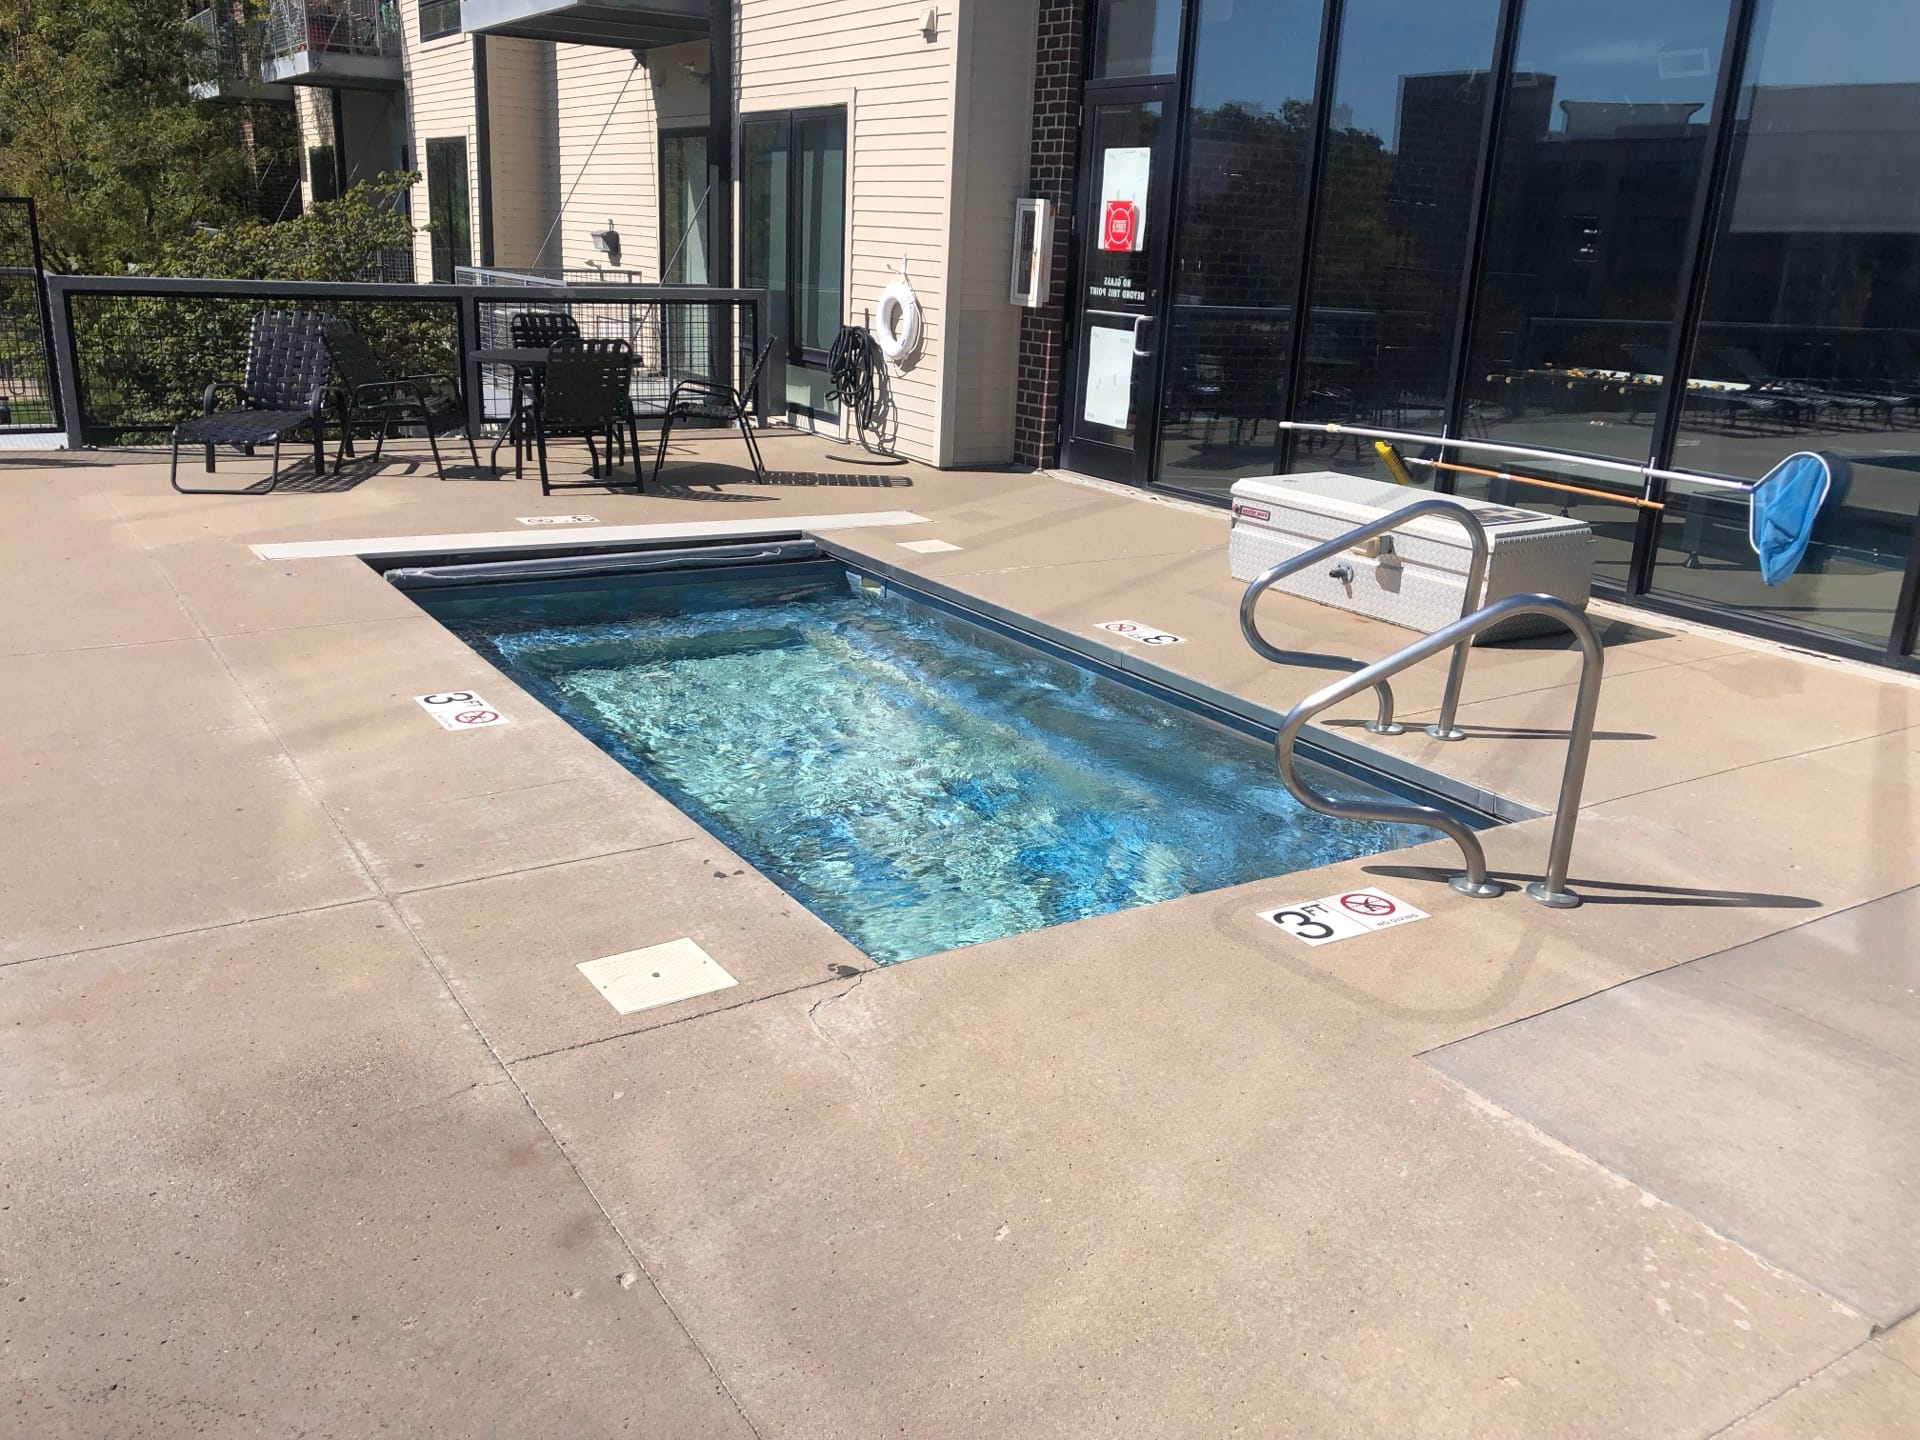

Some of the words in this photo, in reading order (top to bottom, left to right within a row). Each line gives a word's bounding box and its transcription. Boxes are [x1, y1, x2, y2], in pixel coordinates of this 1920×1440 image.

[1142, 635, 1179, 644] 3
[423, 692, 473, 705] 3
[1301, 903, 1329, 917] FT
[1272, 911, 1334, 939] 3
